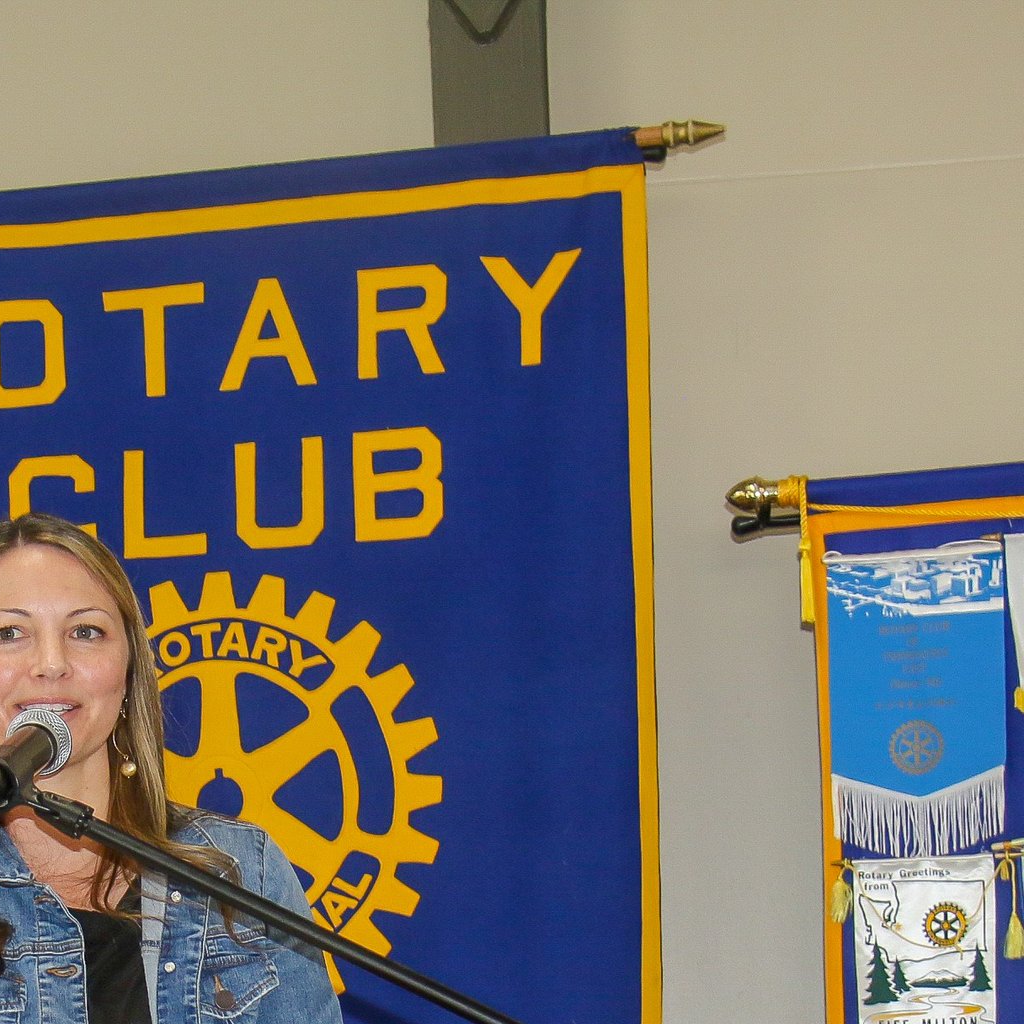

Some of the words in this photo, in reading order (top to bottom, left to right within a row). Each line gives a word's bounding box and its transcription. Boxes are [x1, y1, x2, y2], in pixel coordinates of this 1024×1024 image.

[8, 427, 446, 561] CLUB
[157, 622, 327, 678] OTARY
[858, 871, 893, 880] Rotary
[899, 868, 951, 879] Greetings
[864, 883, 889, 891] from
